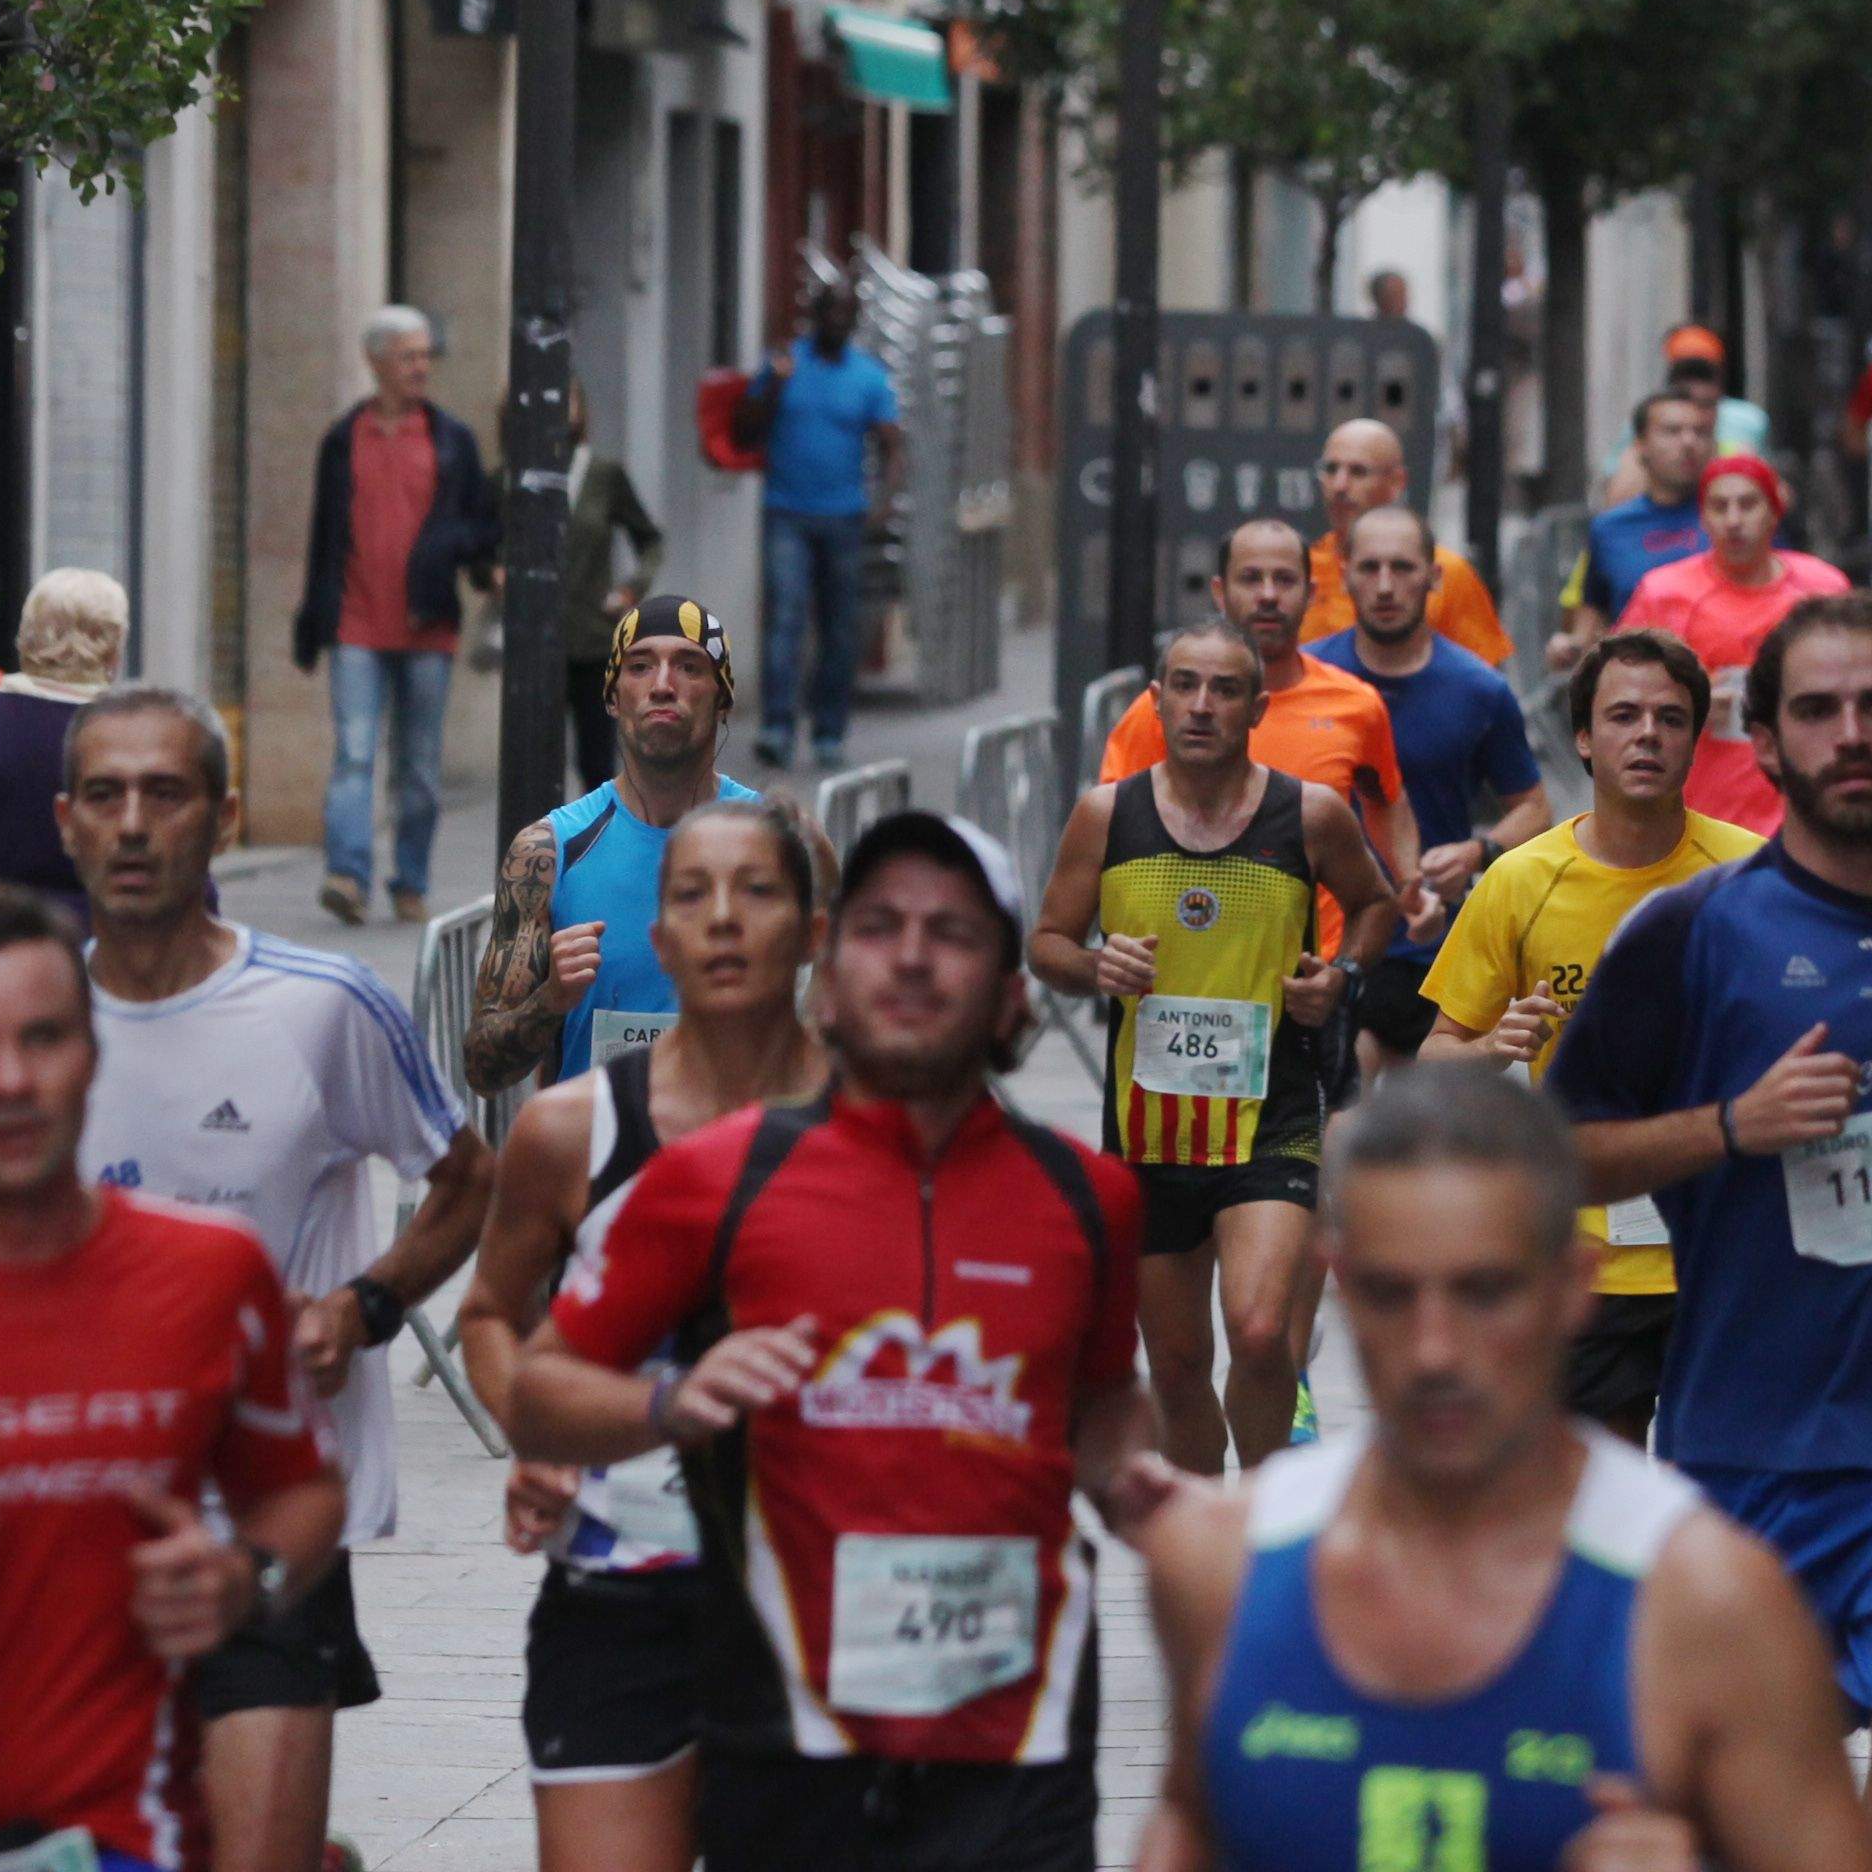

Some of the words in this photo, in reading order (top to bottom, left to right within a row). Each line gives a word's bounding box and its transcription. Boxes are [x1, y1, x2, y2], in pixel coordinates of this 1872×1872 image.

[1157, 1010, 1233, 1028] ANTONIO
[1166, 1032, 1220, 1059] 486
[894, 1600, 985, 1648] 490
